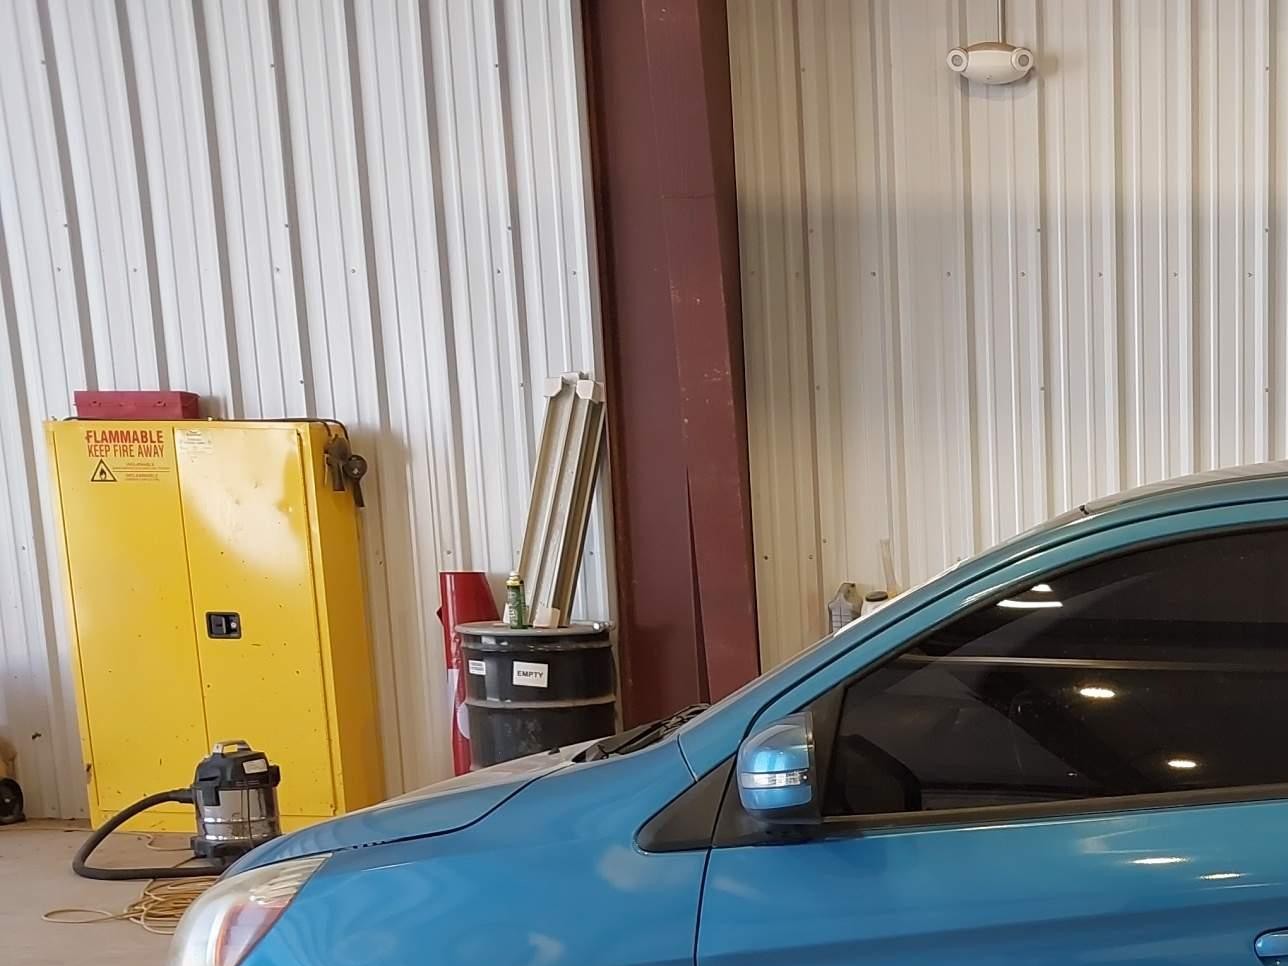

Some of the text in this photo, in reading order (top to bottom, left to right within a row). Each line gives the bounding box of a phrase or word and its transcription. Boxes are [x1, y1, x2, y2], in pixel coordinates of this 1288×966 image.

[85, 430, 164, 443] FLAMMABLE
[88, 444, 164, 457] KEEP FIRE AWAY
[517, 670, 544, 679] EMPTY
